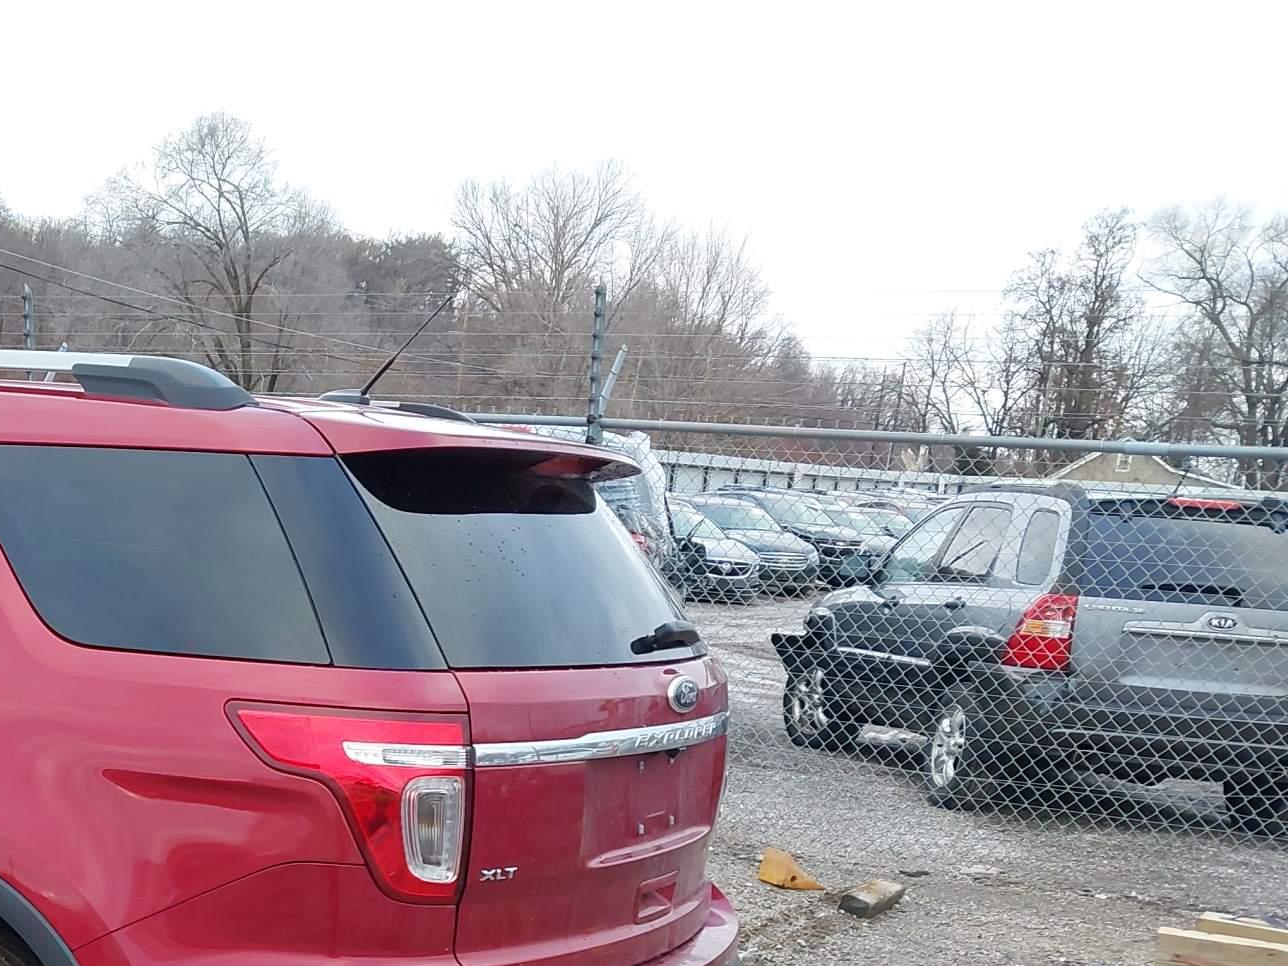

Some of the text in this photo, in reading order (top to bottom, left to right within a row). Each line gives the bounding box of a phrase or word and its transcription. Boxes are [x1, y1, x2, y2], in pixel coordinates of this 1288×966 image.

[1210, 618, 1234, 628] KIA
[680, 681, 698, 705] Ford
[479, 866, 518, 881] XLT
